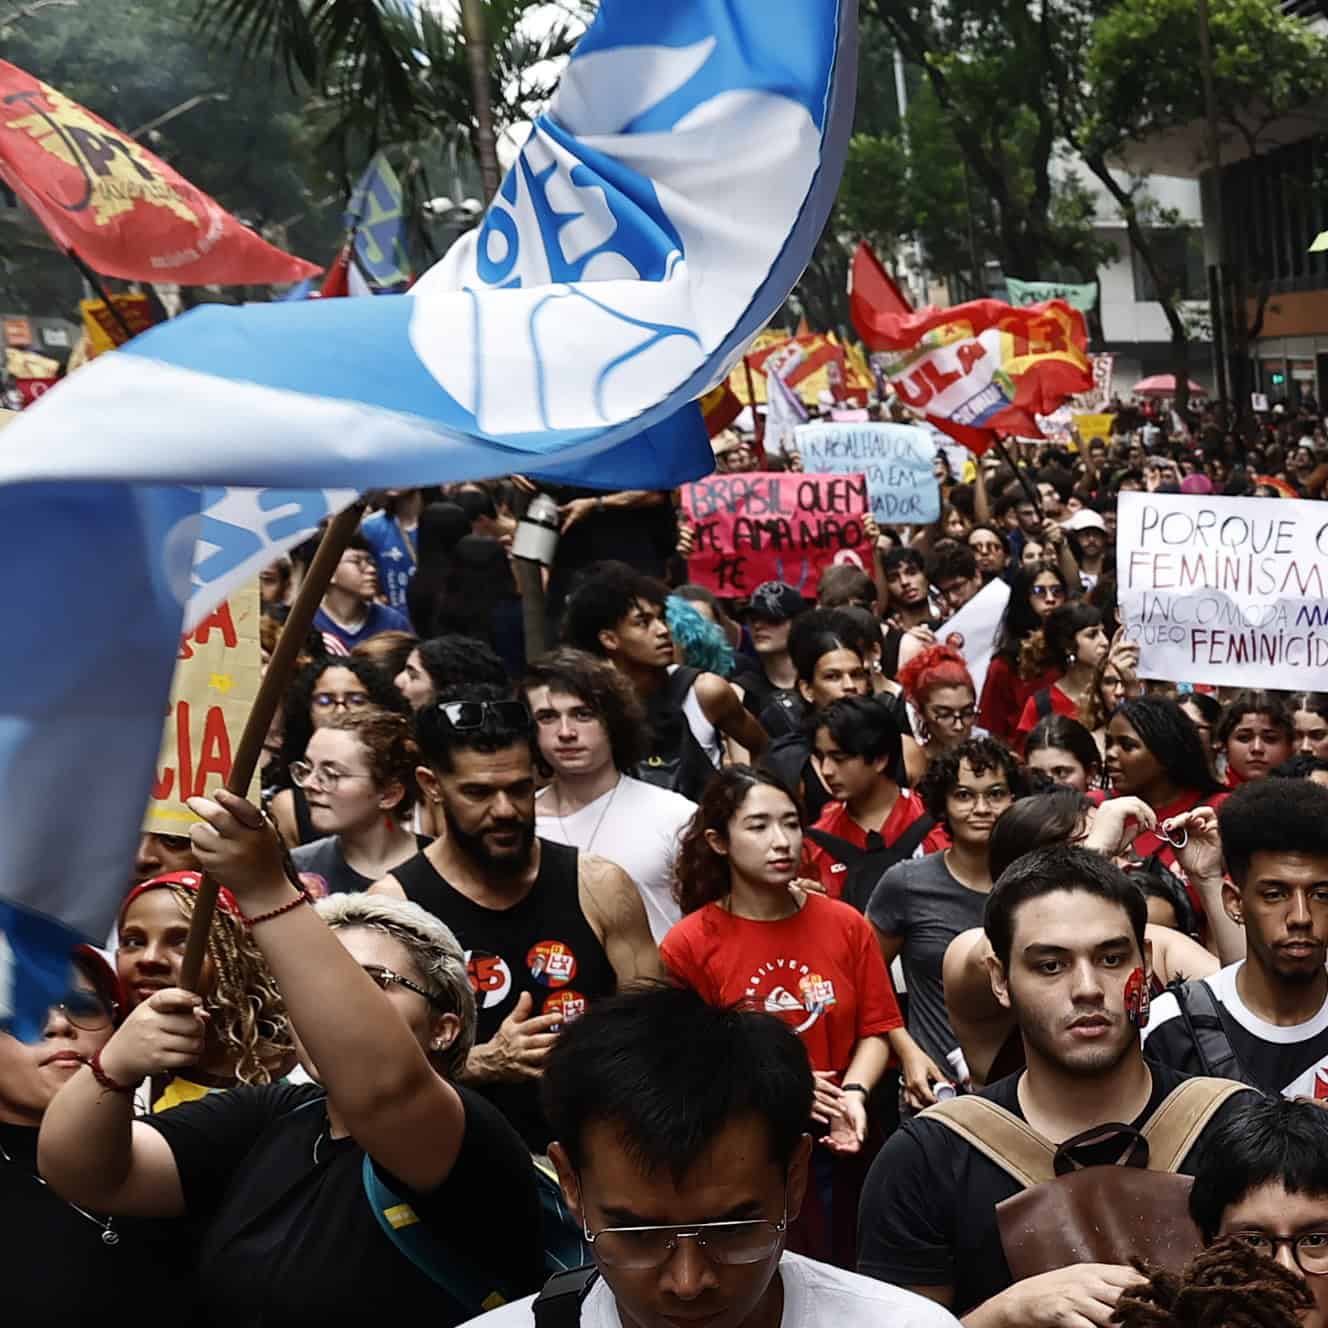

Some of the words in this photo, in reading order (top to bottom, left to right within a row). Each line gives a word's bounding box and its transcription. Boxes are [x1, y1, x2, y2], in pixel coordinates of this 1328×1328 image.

[892, 341, 988, 408] ULA
[798, 479, 869, 514] QUEM
[693, 522, 723, 551] TE
[733, 518, 795, 550] AMA
[1140, 505, 1296, 555] PORQUE
[712, 556, 747, 590] TE
[746, 958, 809, 998] KSILVER
